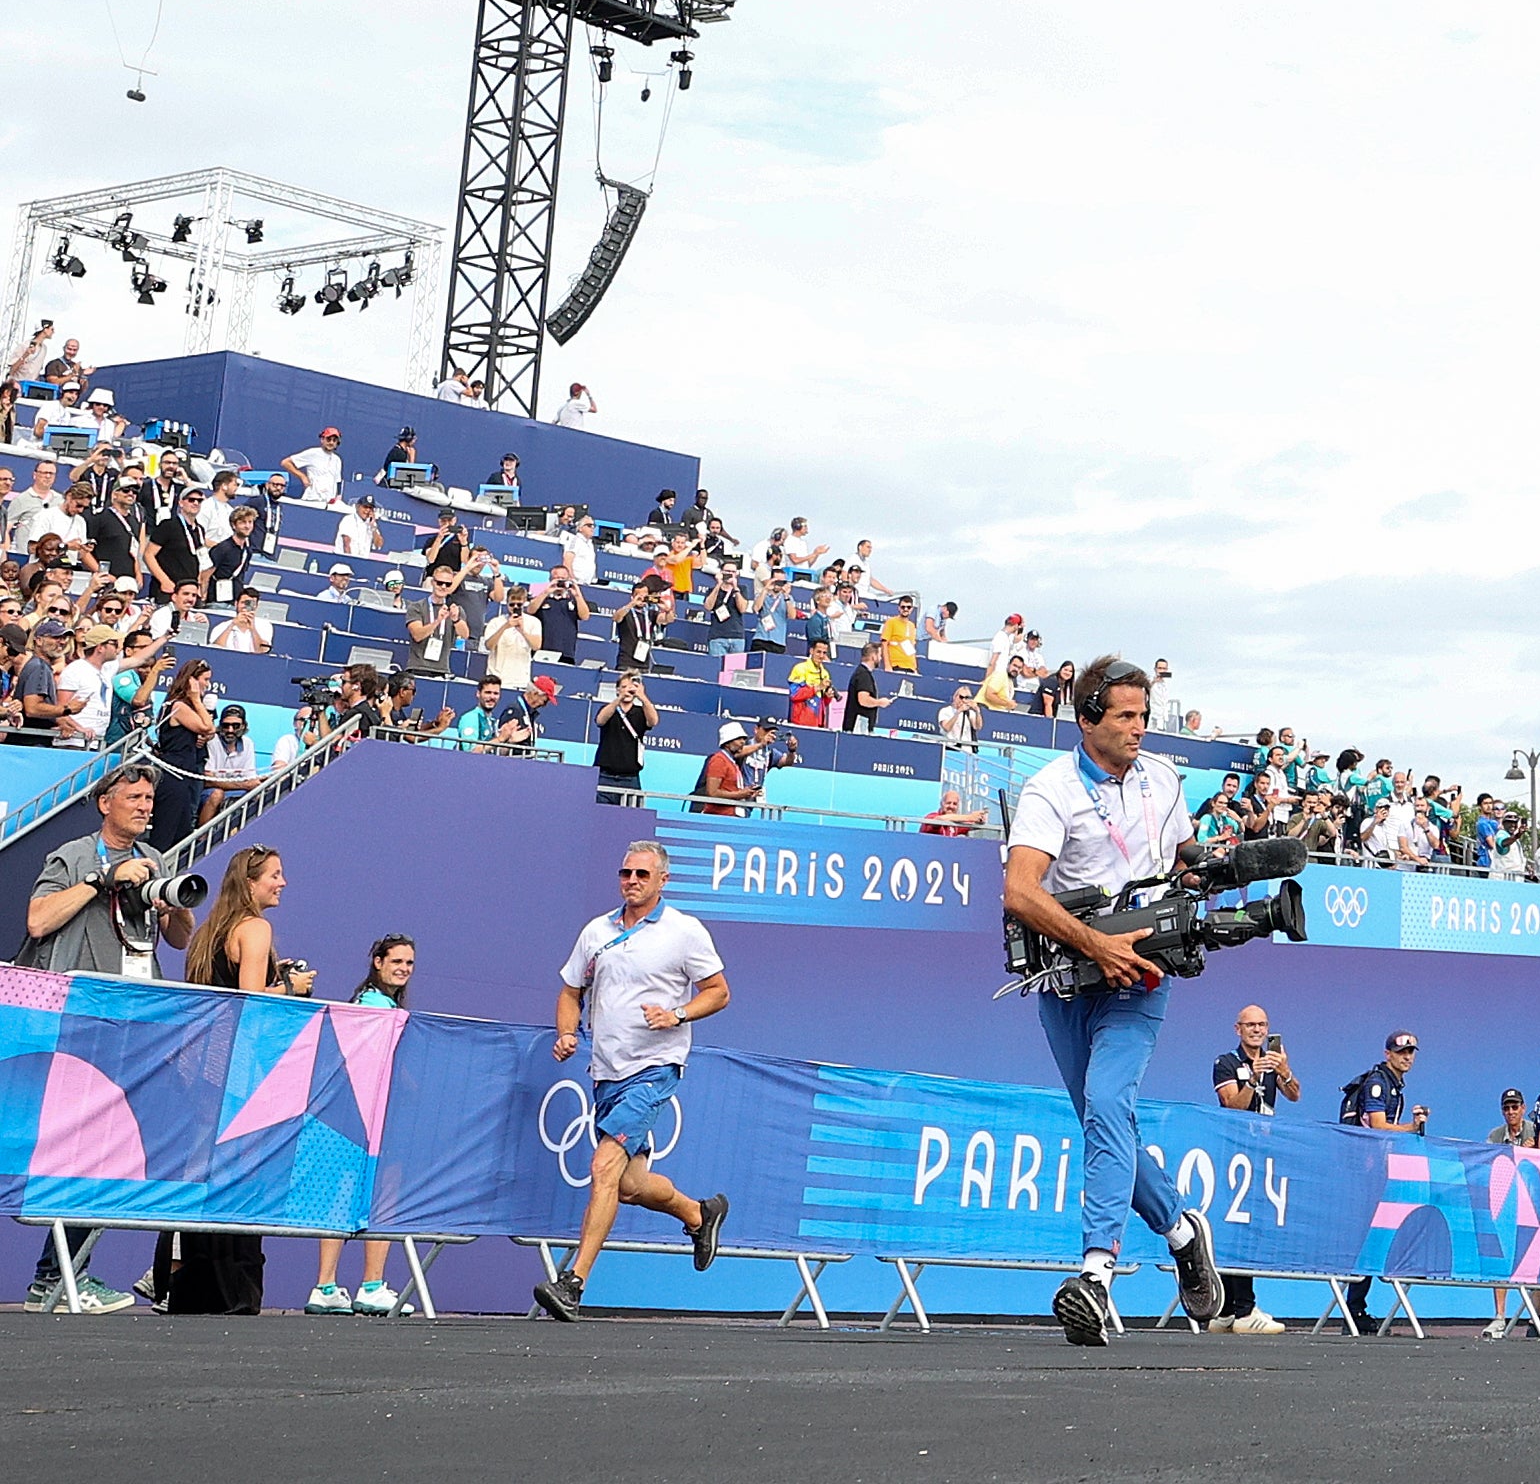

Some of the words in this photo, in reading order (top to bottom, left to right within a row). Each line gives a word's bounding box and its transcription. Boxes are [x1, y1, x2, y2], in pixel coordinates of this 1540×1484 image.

[525, 557, 543, 567] 2024
[898, 719, 918, 730] PARIS
[918, 721, 936, 731] 2024
[658, 737, 681, 749] 2024
[992, 731, 1010, 741] PARIS
[1010, 733, 1028, 743] 2024
[873, 762, 894, 773] PARIS
[895, 765, 914, 776] 2024
[862, 856, 970, 906] 2024
